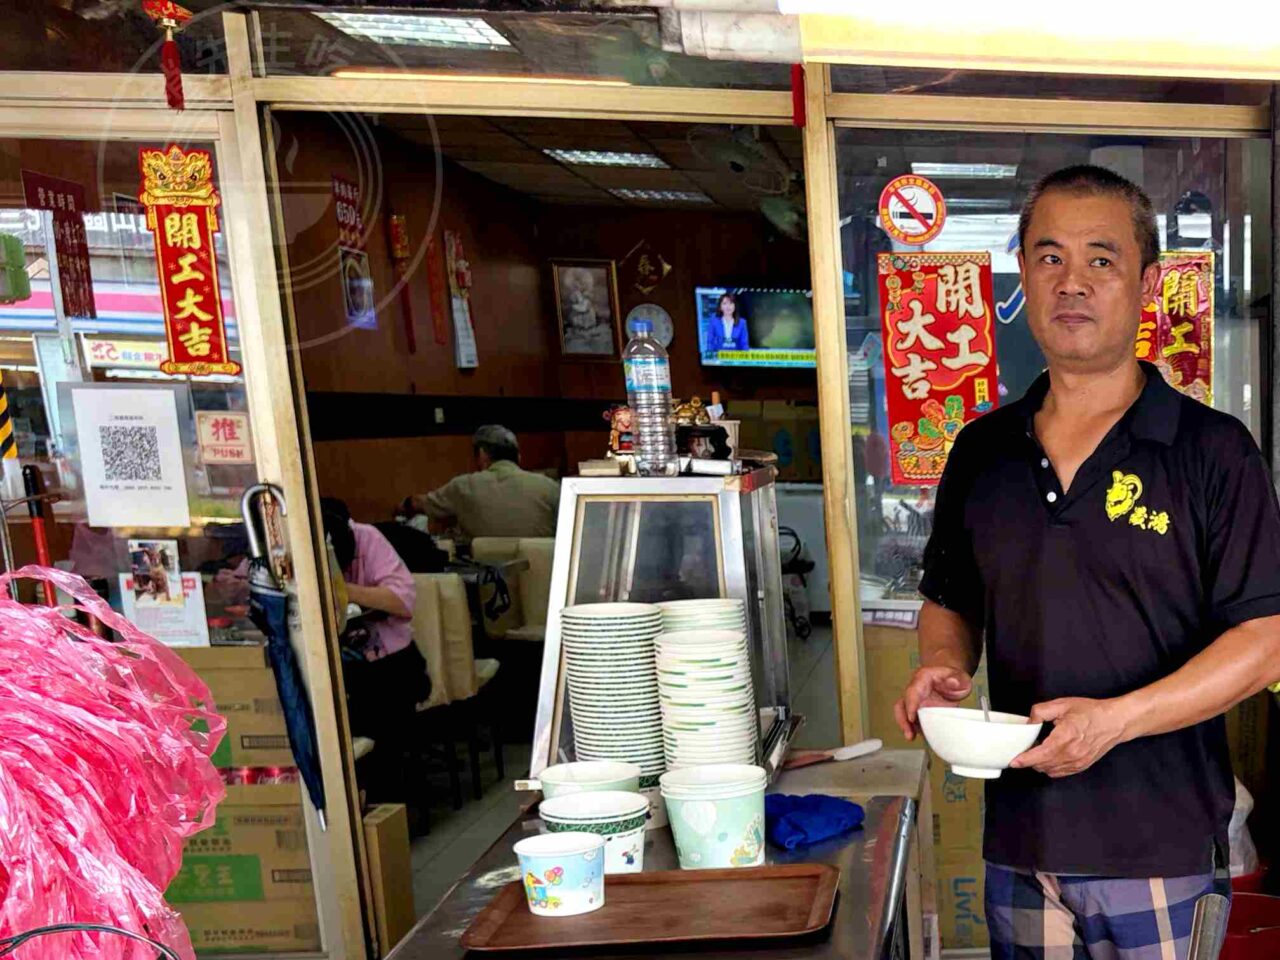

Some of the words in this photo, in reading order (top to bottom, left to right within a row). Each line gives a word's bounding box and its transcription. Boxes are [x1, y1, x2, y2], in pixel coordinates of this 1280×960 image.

[164, 212, 214, 357] 開工大吉
[936, 260, 990, 371] 開工
[1162, 269, 1201, 358] 開工
[891, 299, 945, 400] 大吉
[211, 418, 240, 442] 推
[212, 447, 244, 458] PUSH
